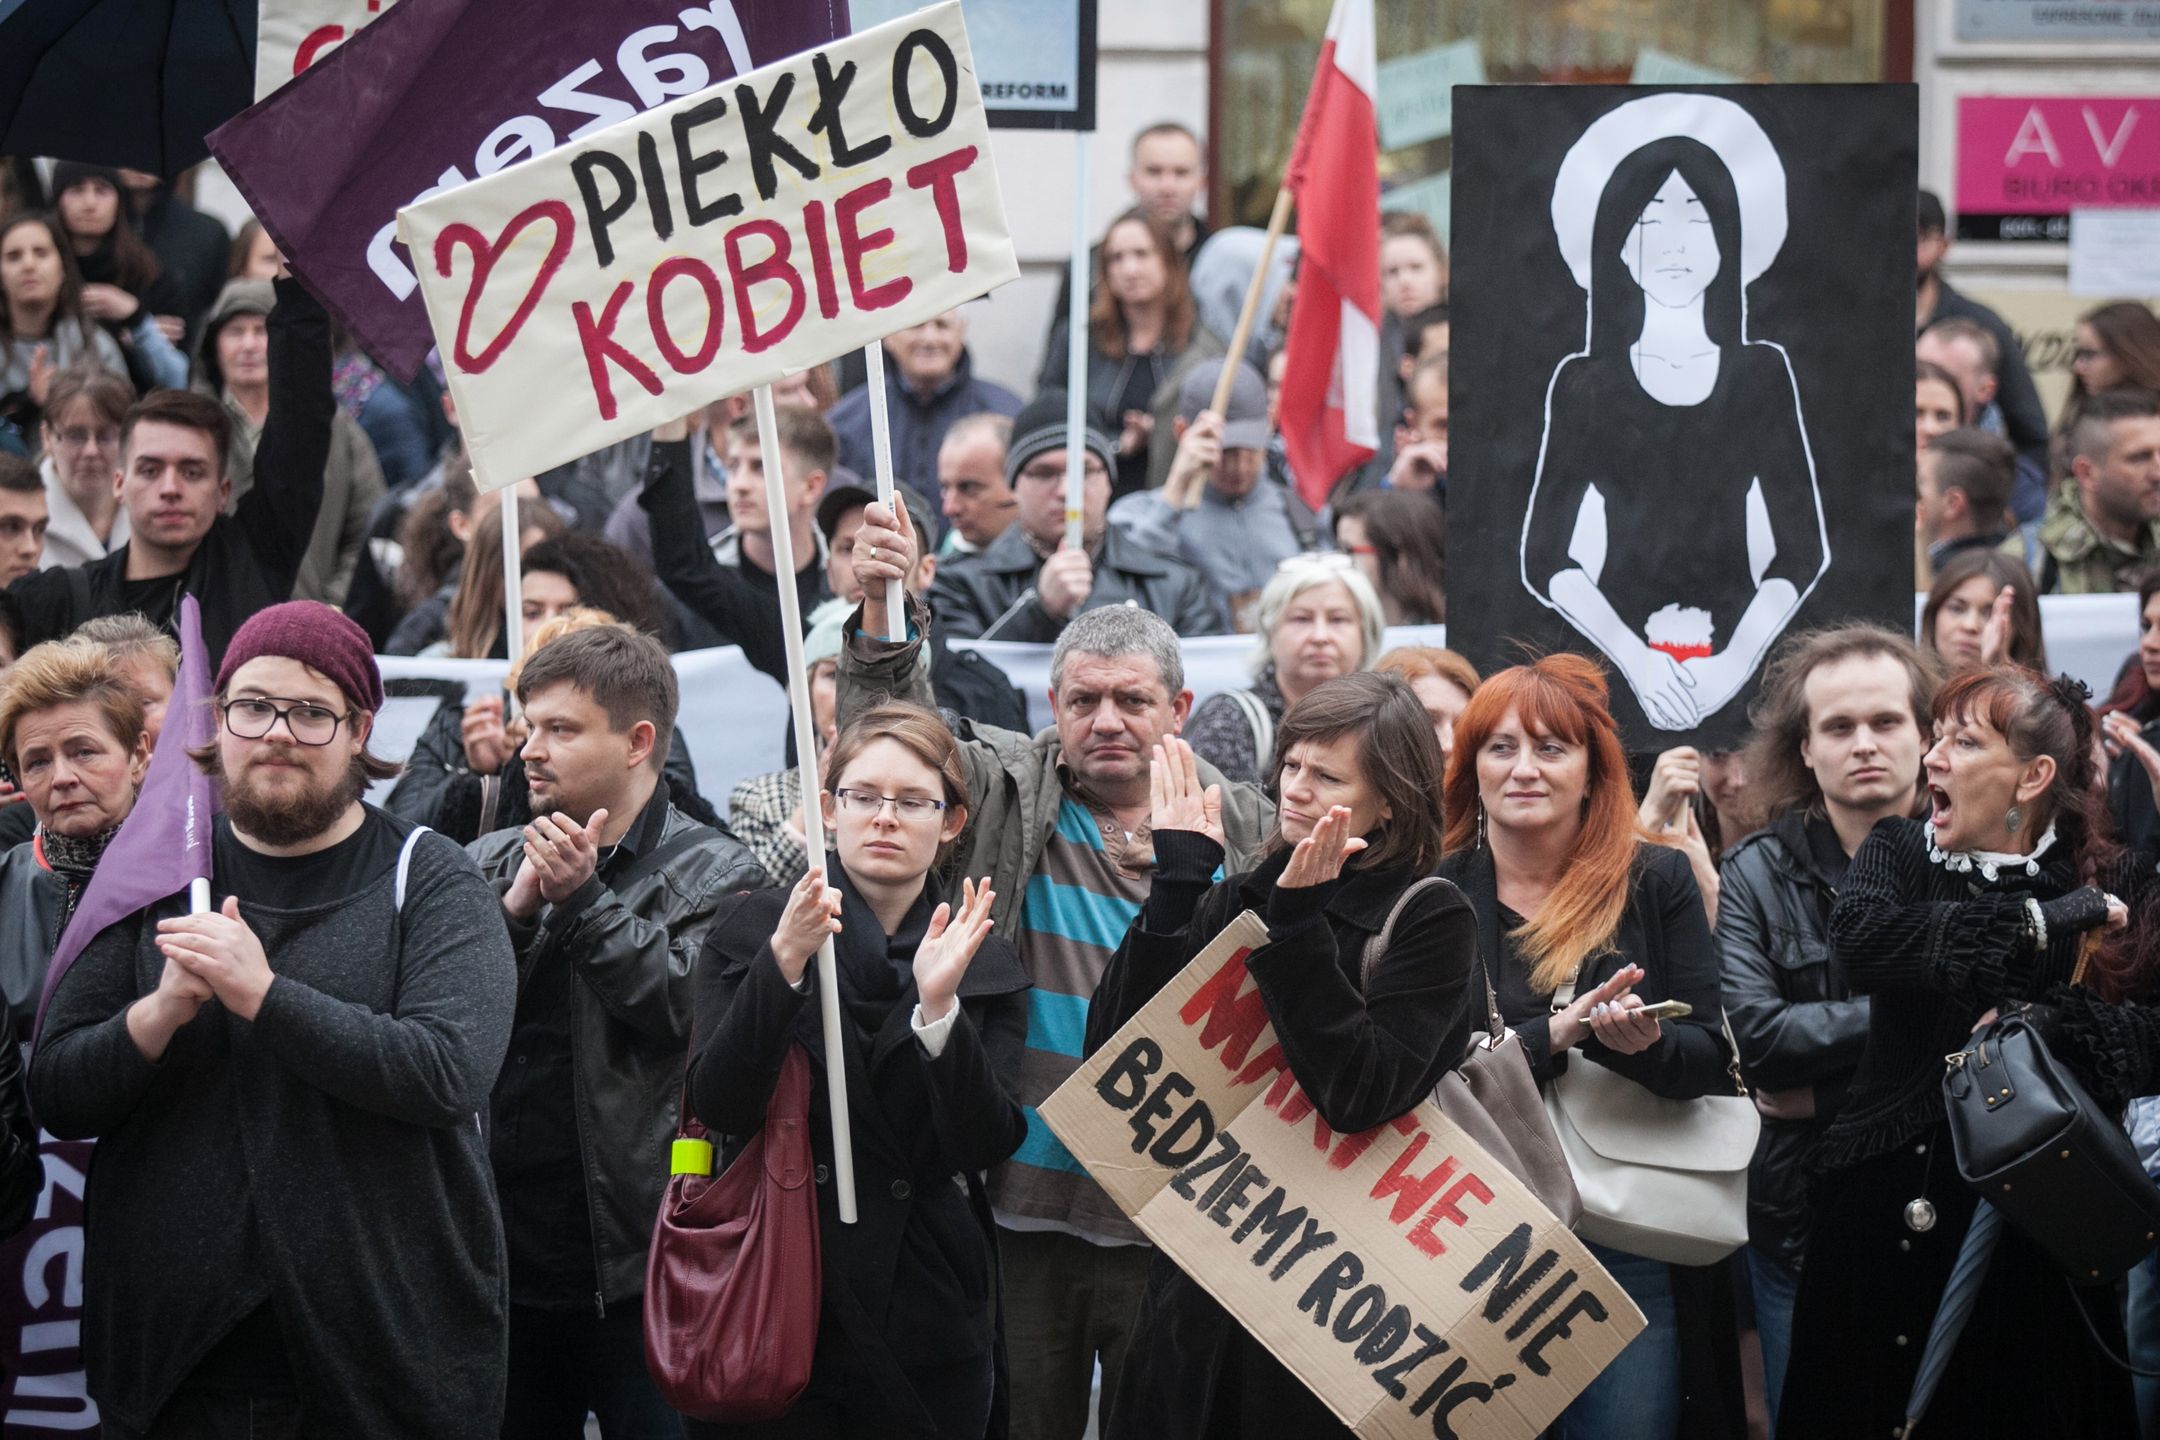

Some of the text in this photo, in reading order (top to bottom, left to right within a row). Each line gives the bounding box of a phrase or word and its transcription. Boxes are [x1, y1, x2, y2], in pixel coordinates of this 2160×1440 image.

[571, 28, 958, 268] PIEKŁO
[981, 83, 1066, 99] REFORM
[2003, 174, 2098, 201] BIURO
[572, 145, 978, 421] KOBIET
[1094, 1036, 1516, 1440] BĘDZIEMY RODZIĆ
[1459, 1222, 1609, 1377] NIE
